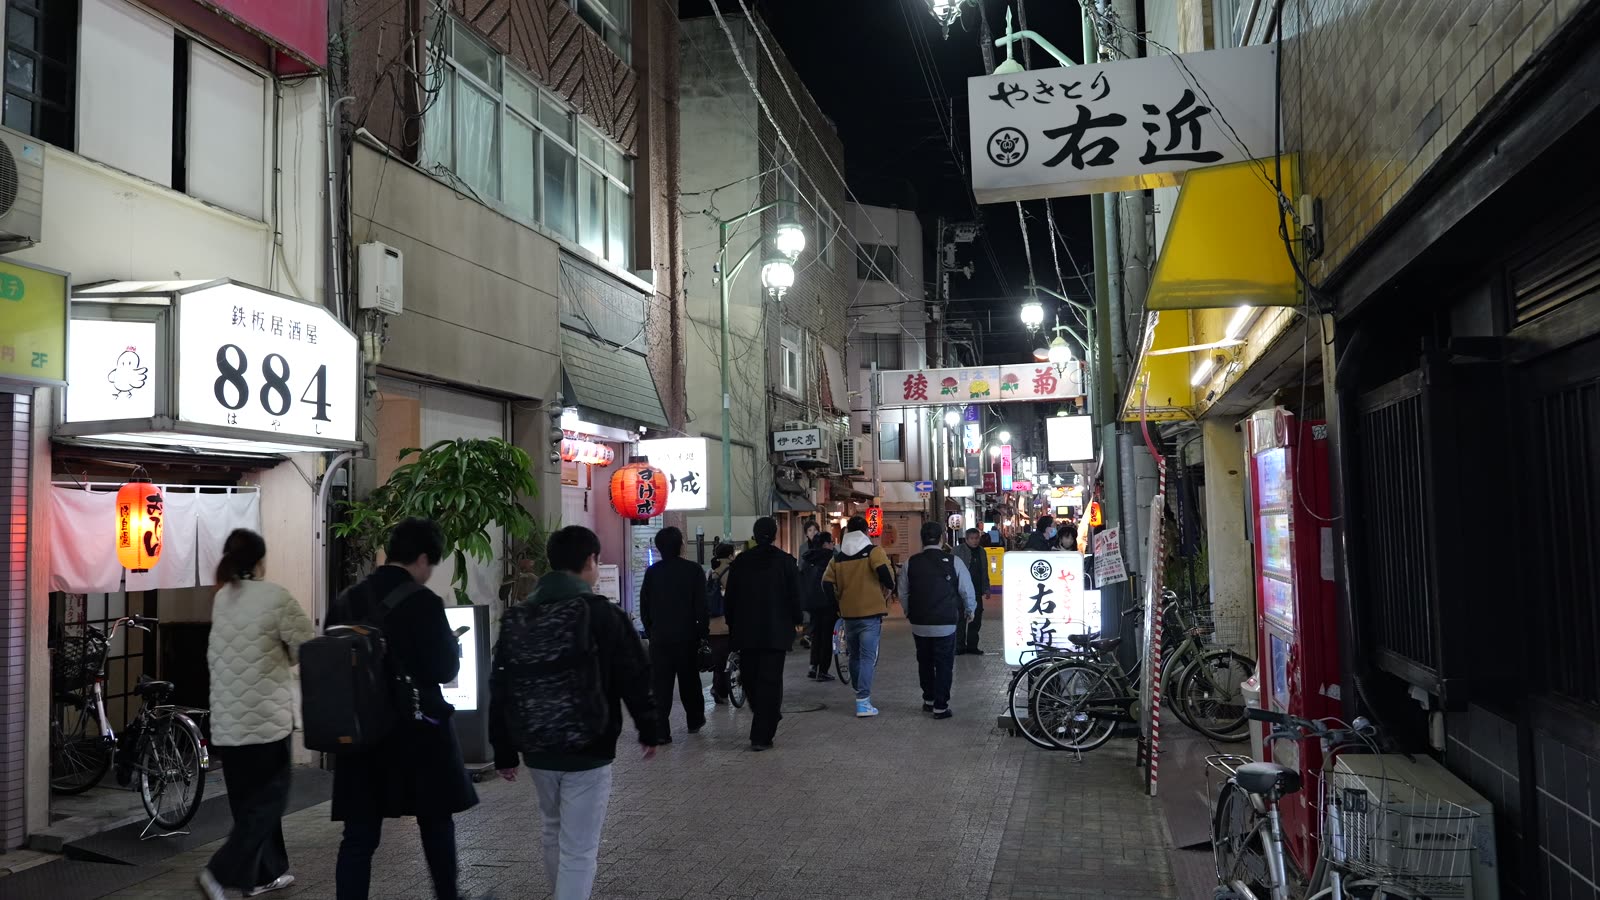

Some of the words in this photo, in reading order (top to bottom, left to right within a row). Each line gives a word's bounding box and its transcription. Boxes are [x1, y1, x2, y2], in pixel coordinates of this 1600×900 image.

[989, 71, 1111, 109] やきとり
[1042, 89, 1225, 170] 右近
[231, 305, 319, 345] 鉄板居酒屋
[31, 351, 48, 368] 2F
[213, 343, 332, 423] 884
[777, 434, 816, 447] 伊吹亭
[636, 468, 656, 515] すけ成
[143, 493, 164, 557] おでん
[1026, 583, 1057, 648] 右近
